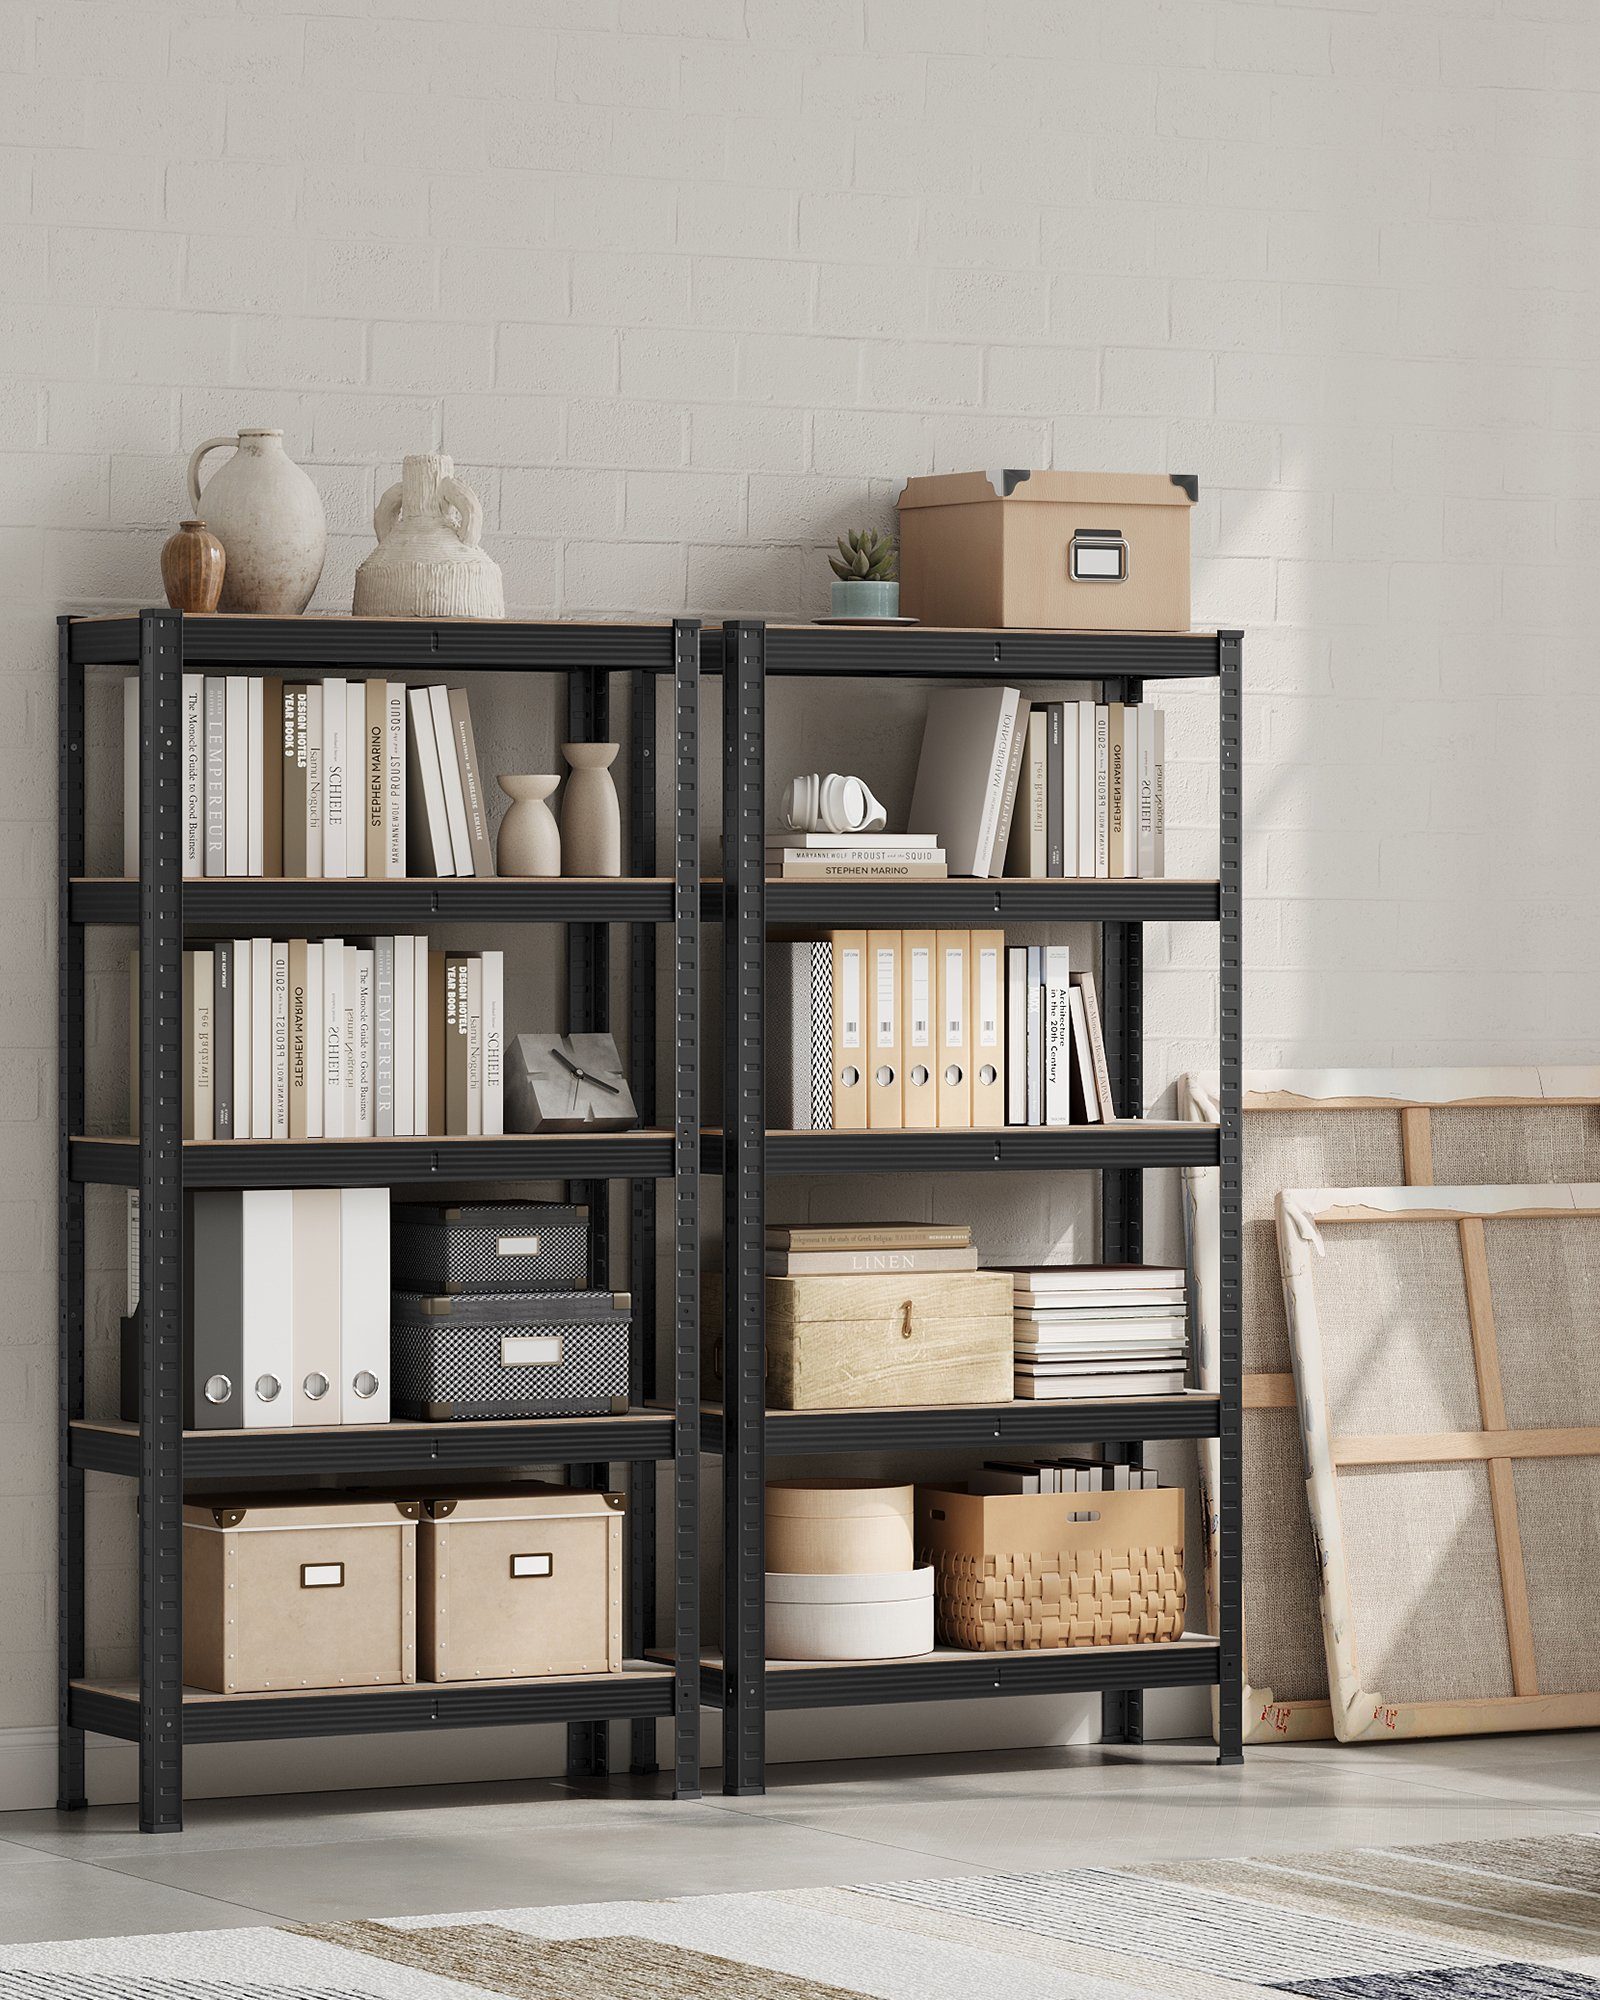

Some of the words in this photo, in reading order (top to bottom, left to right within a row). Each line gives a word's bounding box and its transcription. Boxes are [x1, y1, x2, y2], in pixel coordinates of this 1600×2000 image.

[285, 694, 294, 720] YEAR
[298, 694, 306, 732] DESIGN
[391, 699, 400, 732] SQUID
[285, 723, 294, 747] BOOK
[298, 734, 306, 768] HOTELS
[372, 726, 382, 772] MARINO
[310, 748, 320, 781] Isamu
[391, 756, 400, 796] PROUST
[190, 784, 198, 792] to
[208, 722, 222, 852] LEMPEREUR
[329, 766, 342, 825] SCHIELE
[372, 775, 382, 827] STEPHEN
[308, 782, 320, 828] Noguchi
[360, 968, 368, 984] The
[459, 966, 467, 997] DESIGN
[360, 987, 368, 1022] Monocle
[1051, 989, 1058, 998] in
[1087, 993, 1095, 1010] The
[360, 1024, 368, 1048] Guide
[471, 1016, 479, 1045] Isamu
[1089, 1011, 1098, 1042] Monocle
[378, 982, 390, 1111] LEMPEREUR
[488, 1032, 499, 1086] SCHIELE
[1093, 1044, 1102, 1064] Book
[360, 1061, 368, 1084] Good
[470, 1048, 479, 1089] Noguchi
[1049, 1046, 1057, 1084] Century
[1097, 1065, 1104, 1074] of
[360, 1086, 368, 1120] Business
[1100, 1074, 1109, 1103] JAPAN
[852, 1255, 916, 1269] LINEN
